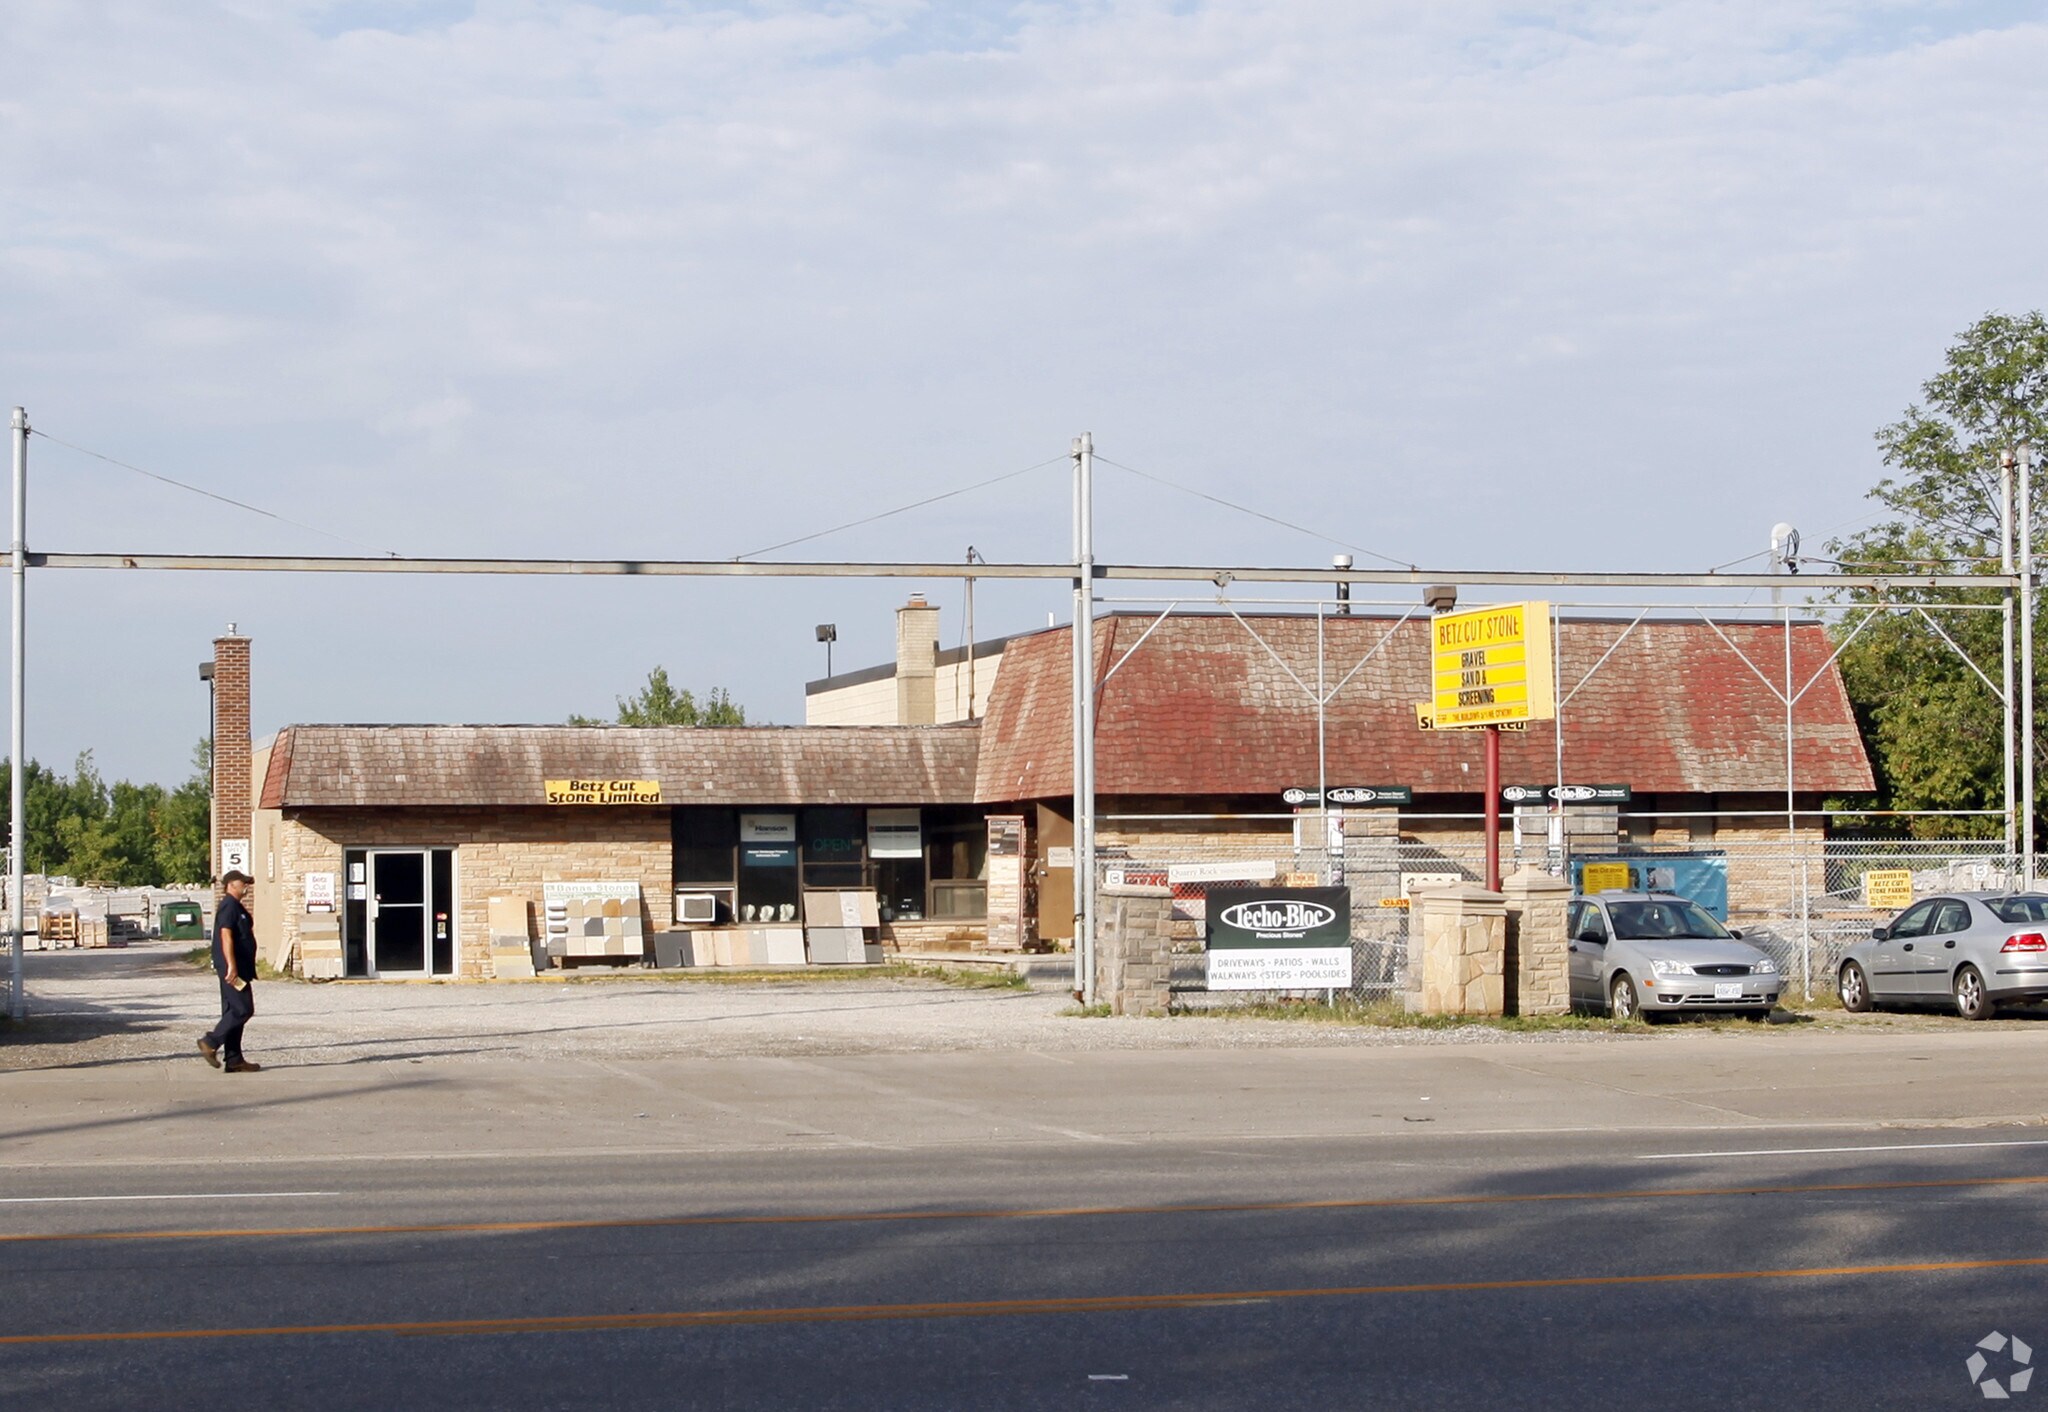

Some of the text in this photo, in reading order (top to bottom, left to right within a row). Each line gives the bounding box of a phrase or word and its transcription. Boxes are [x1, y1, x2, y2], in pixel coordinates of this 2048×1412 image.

[1440, 614, 1519, 646] BETZ CUT STONE
[1461, 650, 1485, 668] GRAVEL
[1461, 670, 1480, 687] SAND
[1458, 688, 1495, 707] SCREENING
[570, 780, 636, 792] Betz Cut
[548, 792, 660, 803] Stone Limited
[812, 838, 851, 852] OPEN
[229, 853, 242, 865] 5
[596, 884, 636, 892] Stones
[1232, 904, 1323, 928] Techo-Bloc
[1217, 957, 1340, 968] DRIVEWAYS PATIOS WALLS
[1210, 969, 1347, 980] WALKWAYS STEPS POOLSIDES
